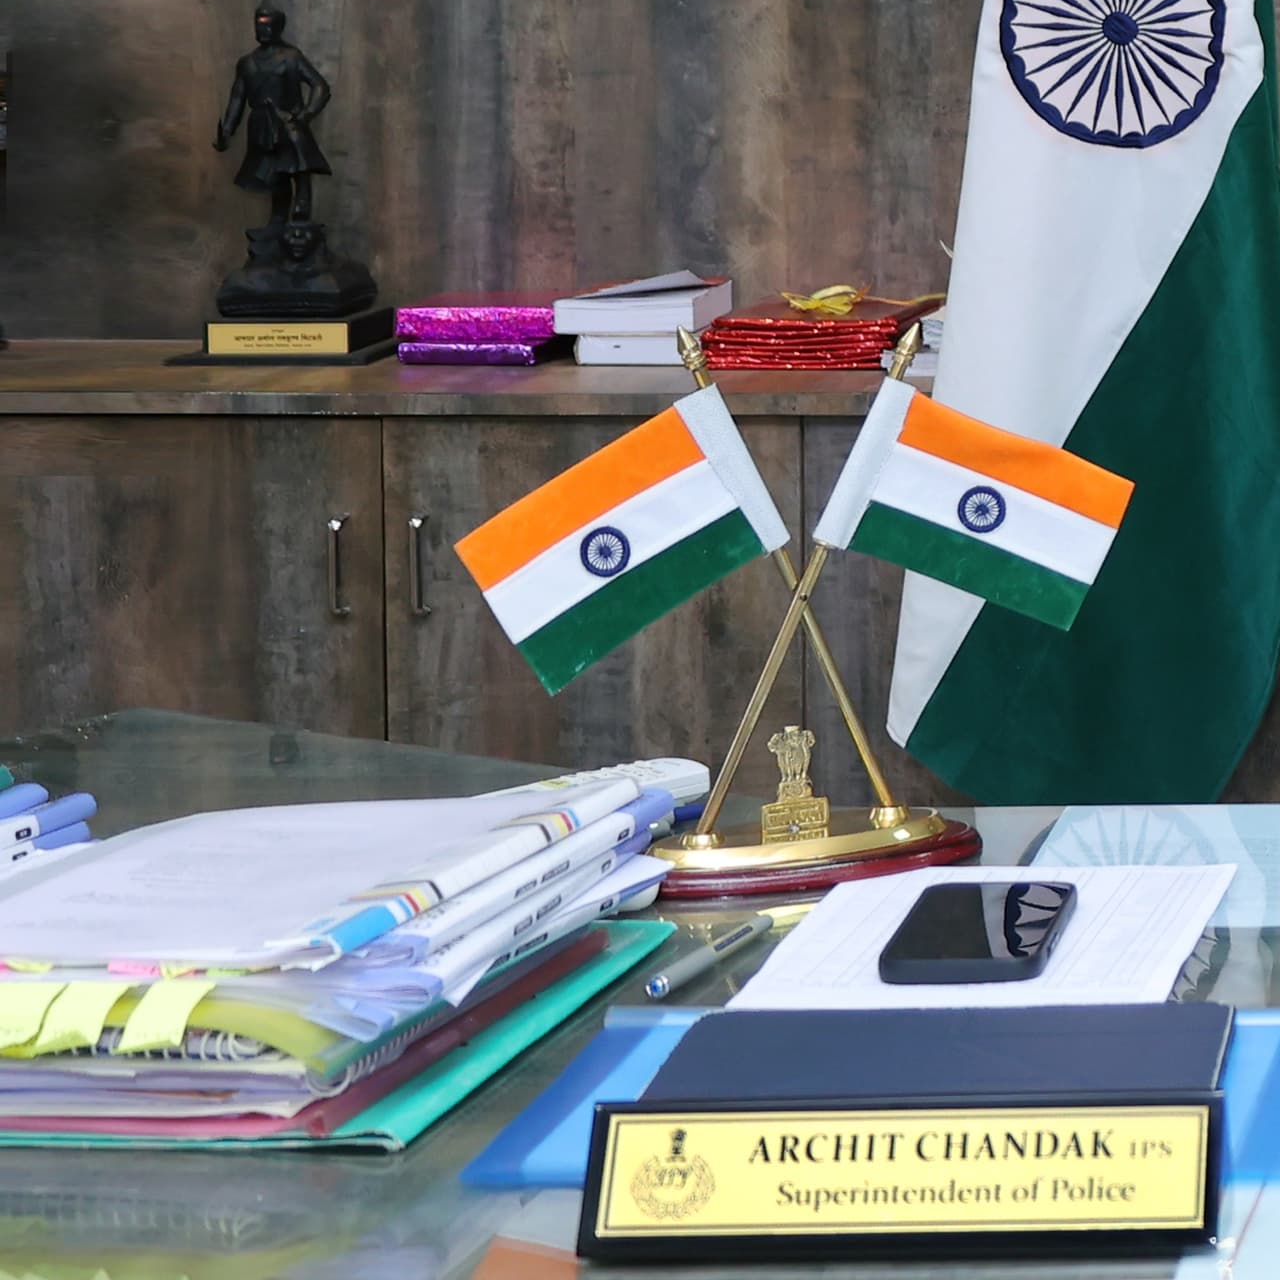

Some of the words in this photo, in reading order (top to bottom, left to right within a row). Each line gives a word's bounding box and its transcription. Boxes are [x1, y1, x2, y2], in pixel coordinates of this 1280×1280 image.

[749, 1130, 904, 1166] ARCHIT
[916, 1128, 1116, 1163] CHANDAK
[1129, 1139, 1173, 1160] IPS
[776, 1179, 1000, 1213] Superintendent
[1012, 1178, 1041, 1204] of
[1050, 1177, 1136, 1203] Police
